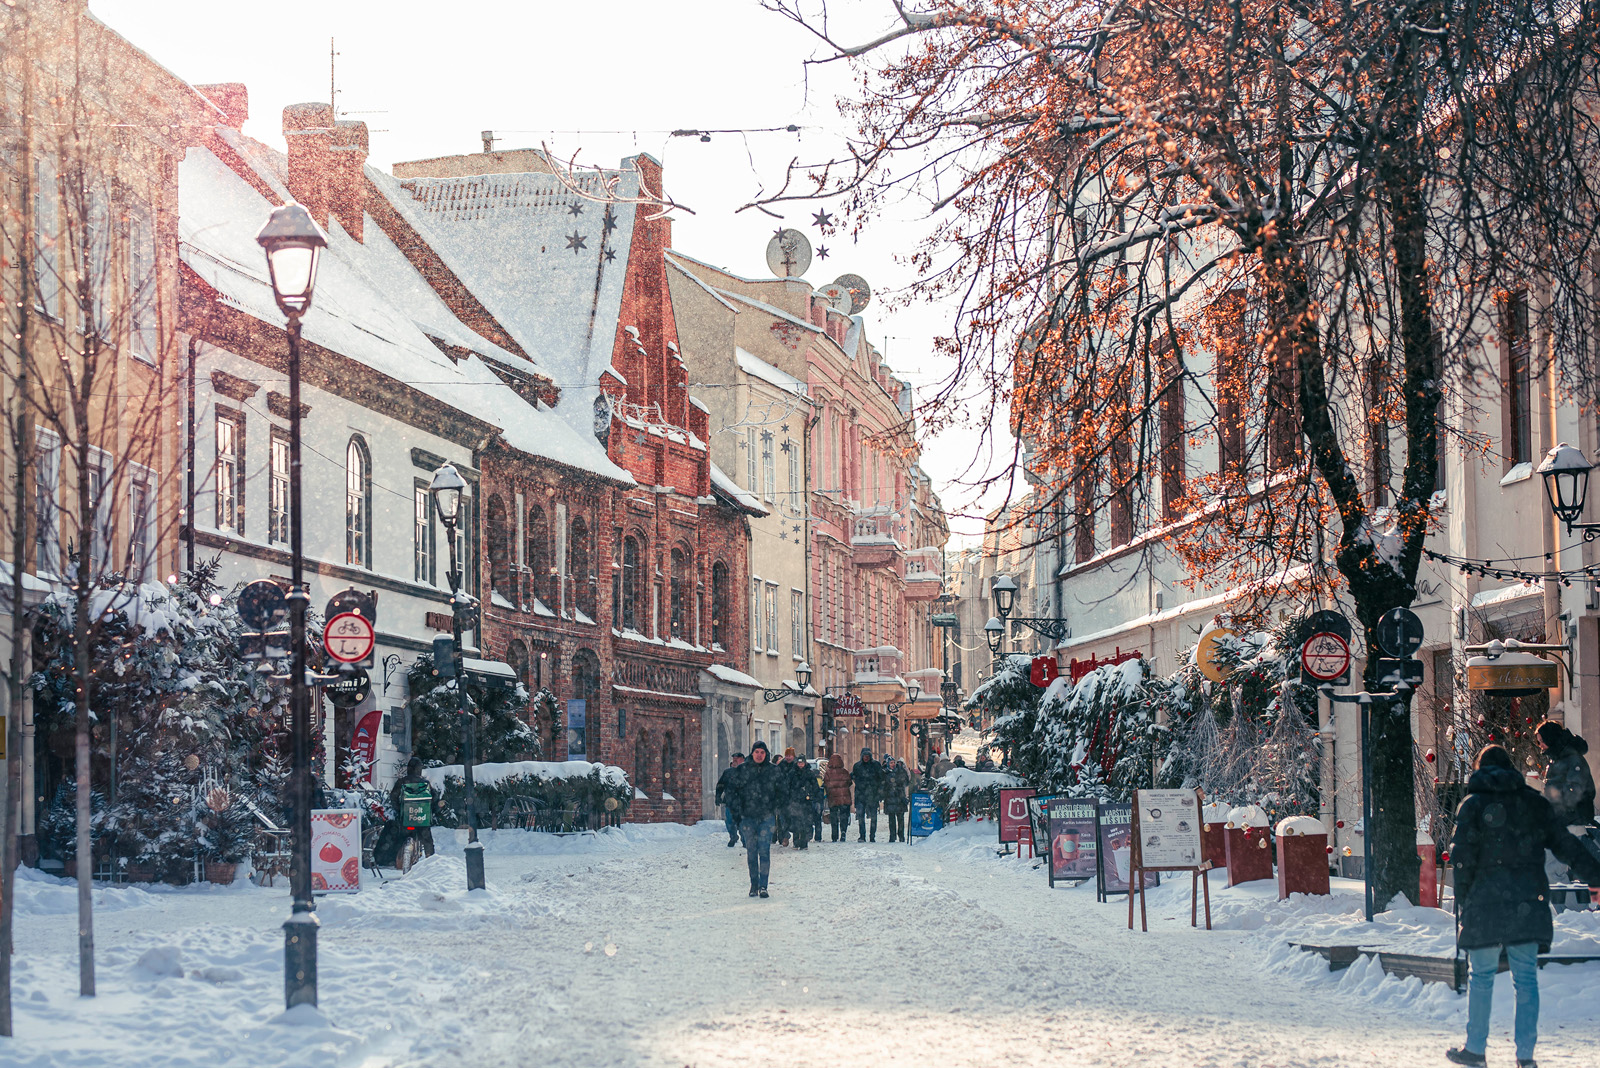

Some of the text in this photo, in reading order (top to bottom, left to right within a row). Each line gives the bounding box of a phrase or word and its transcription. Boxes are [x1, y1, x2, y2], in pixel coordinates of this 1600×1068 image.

[409, 806, 423, 814] Bolt
[1054, 803, 1073, 811] KARŠTI
[1055, 810, 1094, 818] IŠSINEŠTI
[1104, 808, 1124, 817] KARŠTI
[1106, 816, 1132, 824] IŠSINE
